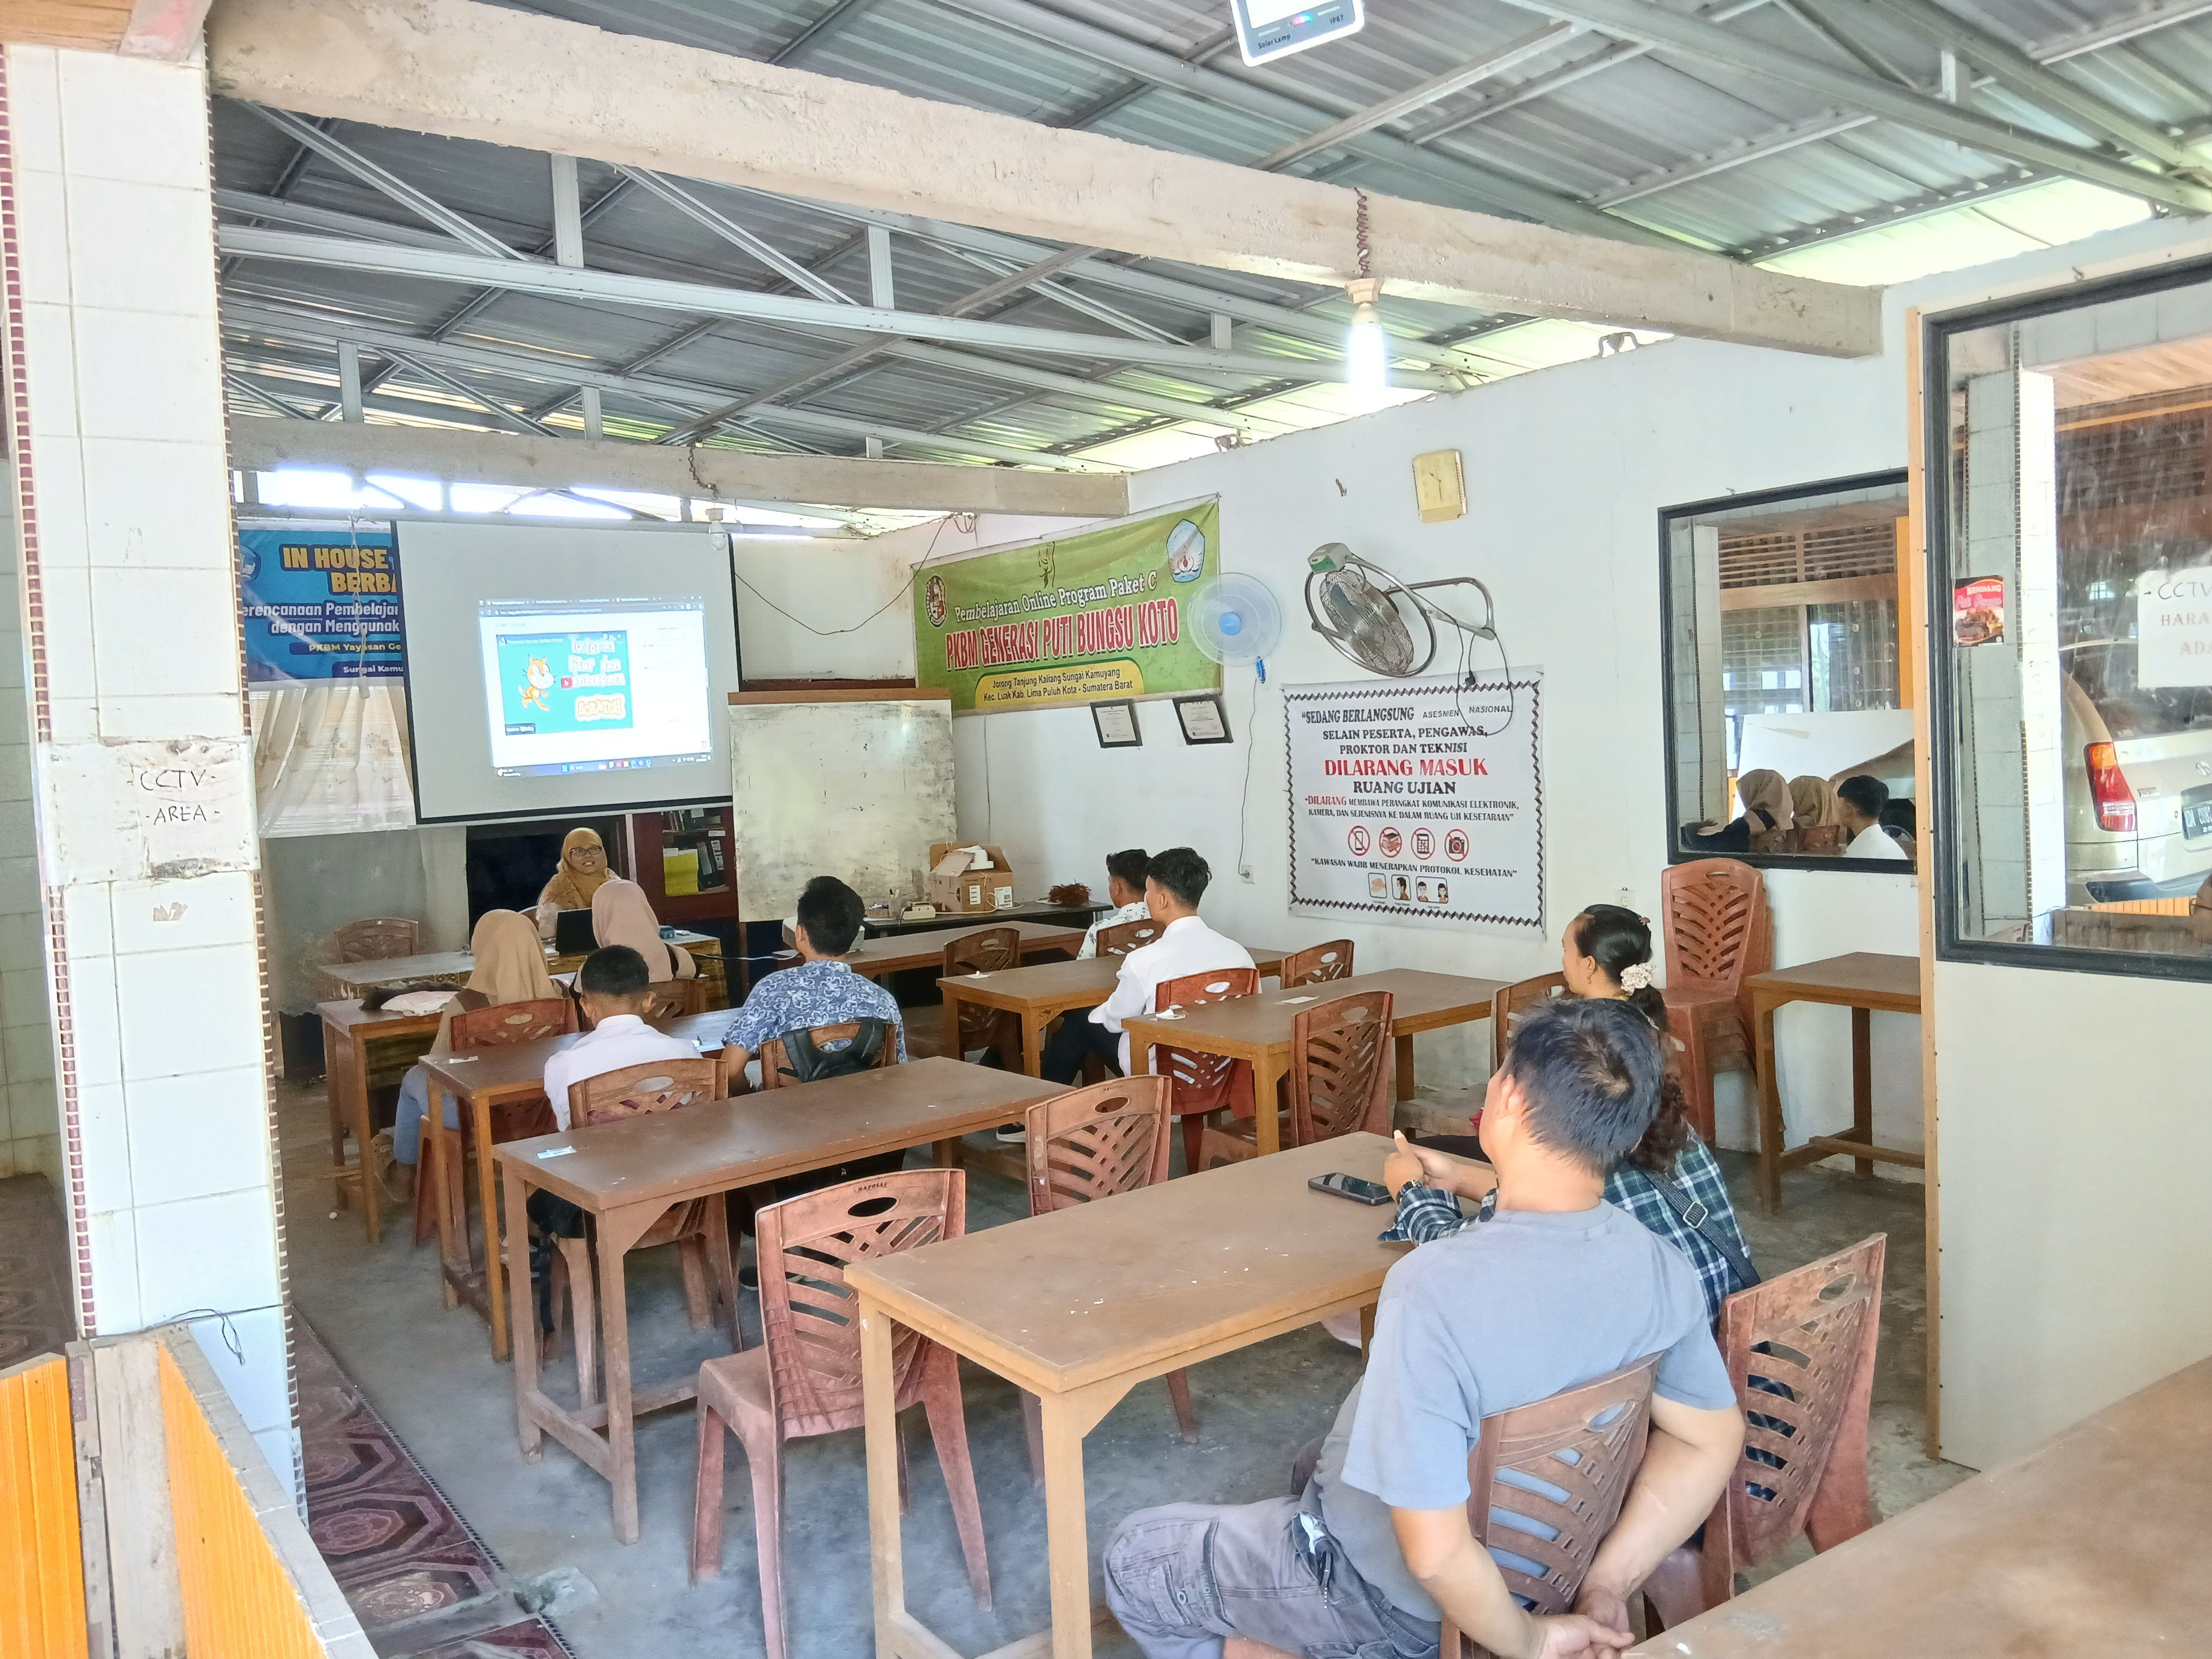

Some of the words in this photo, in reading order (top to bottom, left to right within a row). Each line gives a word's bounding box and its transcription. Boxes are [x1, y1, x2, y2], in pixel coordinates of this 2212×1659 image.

[1330, 15, 1344, 24] IP67
[1258, 40, 1274, 49] Solar
[1274, 34, 1291, 44] Lamp
[282, 547, 308, 568] IN
[314, 548, 389, 569] HOUSE
[954, 601, 1020, 623] Pembelajaran
[1021, 591, 1057, 612] Online
[1057, 584, 1107, 607] Program
[1108, 575, 1145, 597] Paket
[1147, 571, 1158, 590] C
[2158, 582, 2212, 600] CCTV
[271, 620, 321, 635] dengan
[946, 629, 980, 671] PKBM
[979, 620, 1040, 667] GENERASI
[1043, 614, 1073, 659] PUTI
[1077, 604, 1134, 655] BUNGSU
[1137, 596, 1180, 647] KOTO
[308, 644, 340, 652] PKBM
[343, 643, 385, 652] Yayasan
[343, 665, 376, 675] Sungai
[993, 679, 1012, 690] Jorong
[1013, 677, 1037, 687] Tanjung
[1062, 671, 1084, 683] Sungai
[1085, 668, 1120, 680] Kamuyang
[984, 693, 996, 702] Kec.
[998, 691, 1012, 700] Luak
[1013, 689, 1026, 699] Kab.
[1027, 688, 1042, 698] Lima
[1043, 686, 1061, 697] Puluh
[1063, 685, 1077, 695] Kota
[1082, 683, 1113, 693] Sumatera
[1115, 680, 1133, 690] Barat
[1342, 707, 1414, 724] BERLANGSUNG
[1422, 710, 1460, 719] ASESMEN
[1469, 706, 1513, 714] NASIONAL
[1323, 730, 1360, 740] SELAIN
[1362, 729, 1416, 741] PESERTA,
[1418, 725, 1488, 738] PENGAWAS,
[1339, 744, 1390, 755] PROKTOR
[1392, 743, 1417, 754] DAN
[1419, 742, 1468, 753] TEKNISI
[1324, 759, 1413, 776] DILARANG
[1419, 758, 1488, 776] MASUK
[140, 769, 206, 791] CCTV
[1353, 781, 1404, 794] RUANG
[1407, 781, 1456, 794] UJIAN
[1349, 799, 1380, 807] MEMBAWA
[1382, 799, 1420, 807] PERANGKAT
[1422, 800, 1467, 808] KOMUNIKASI
[1470, 800, 1519, 809] ELEKTRONIK,
[153, 805, 207, 826] AREA
[1309, 809, 1335, 817] KAMERA,
[1350, 809, 1387, 818] SEJENISNYA
[1399, 811, 1422, 819] DALAM
[1424, 812, 1448, 820] RUANG
[1450, 812, 1461, 820] UJI
[1347, 860, 1368, 869] WAJIB
[1369, 861, 1418, 872] MENERAPKAN
[1419, 865, 1462, 874] PROTOKOL
